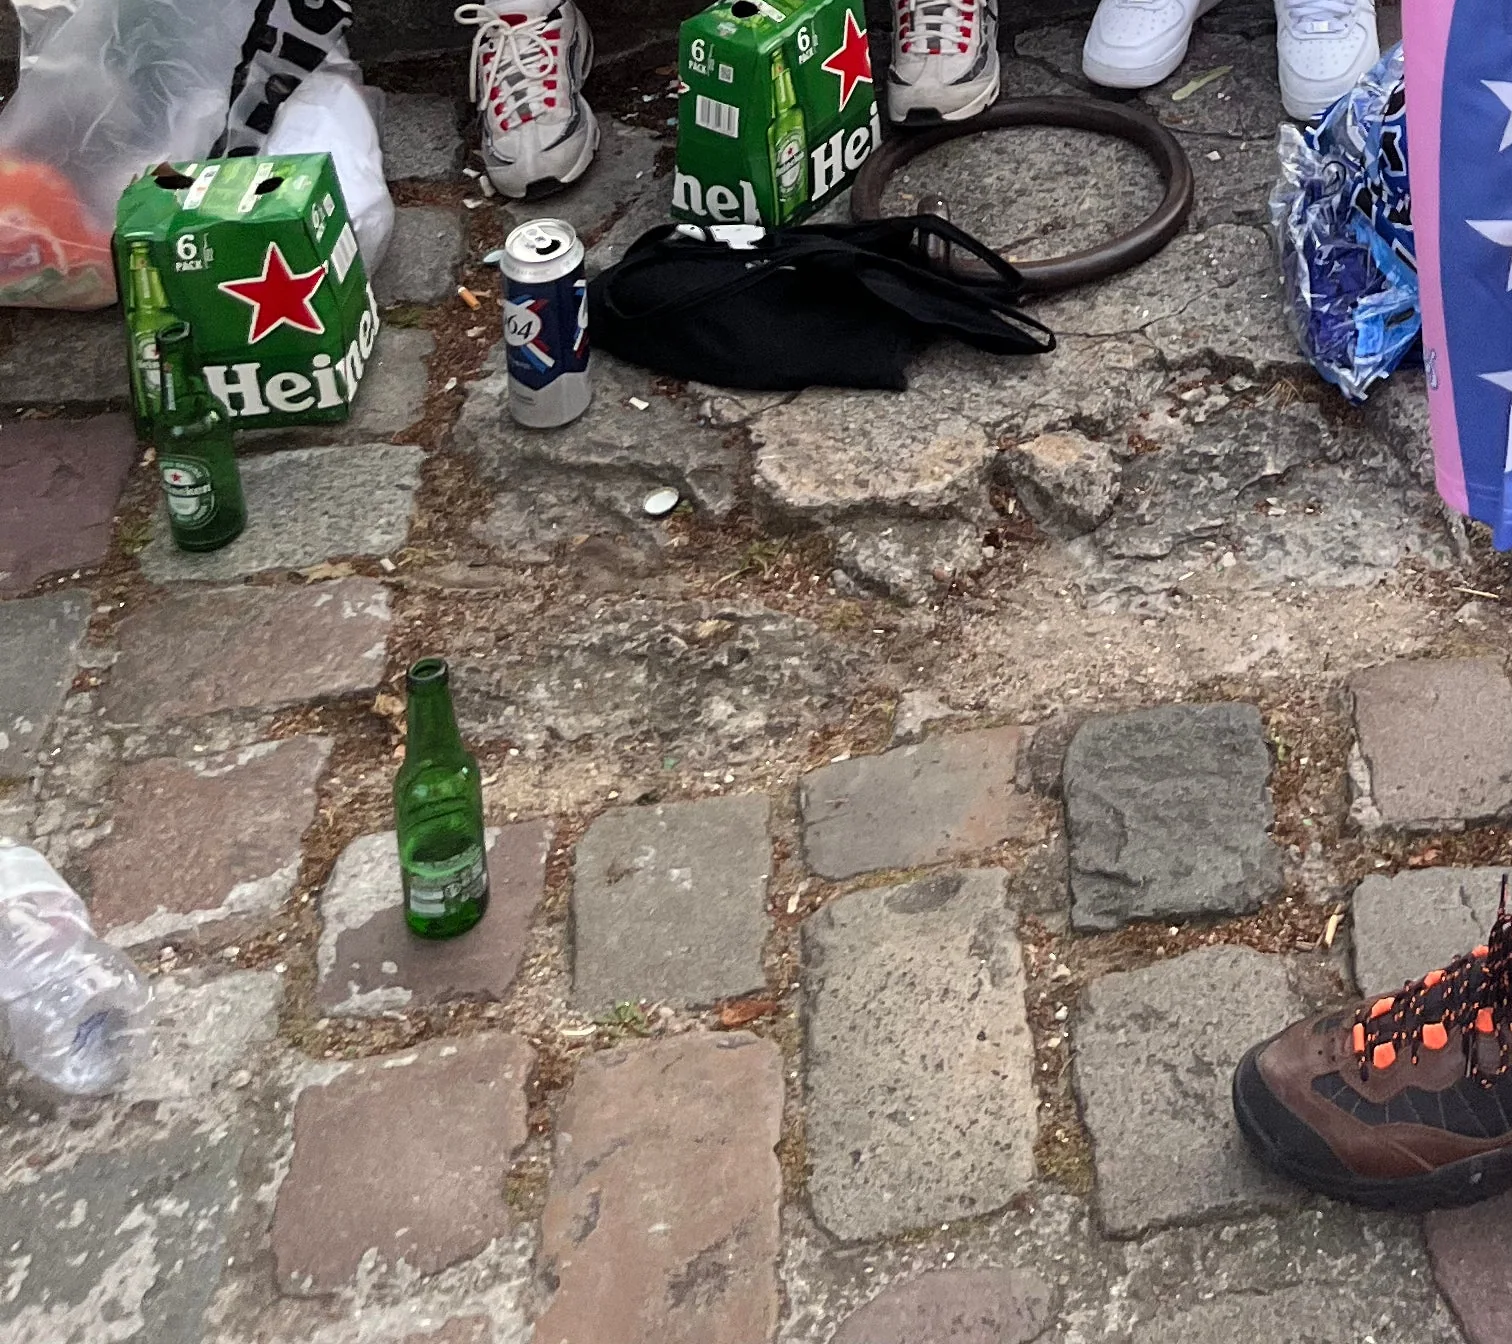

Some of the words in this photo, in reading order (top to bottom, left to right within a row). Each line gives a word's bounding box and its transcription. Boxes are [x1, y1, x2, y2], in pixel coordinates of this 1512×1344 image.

[691, 39, 706, 62] 6
[797, 26, 810, 51] 6
[176, 234, 197, 260] 6
[175, 261, 202, 272] PACK
